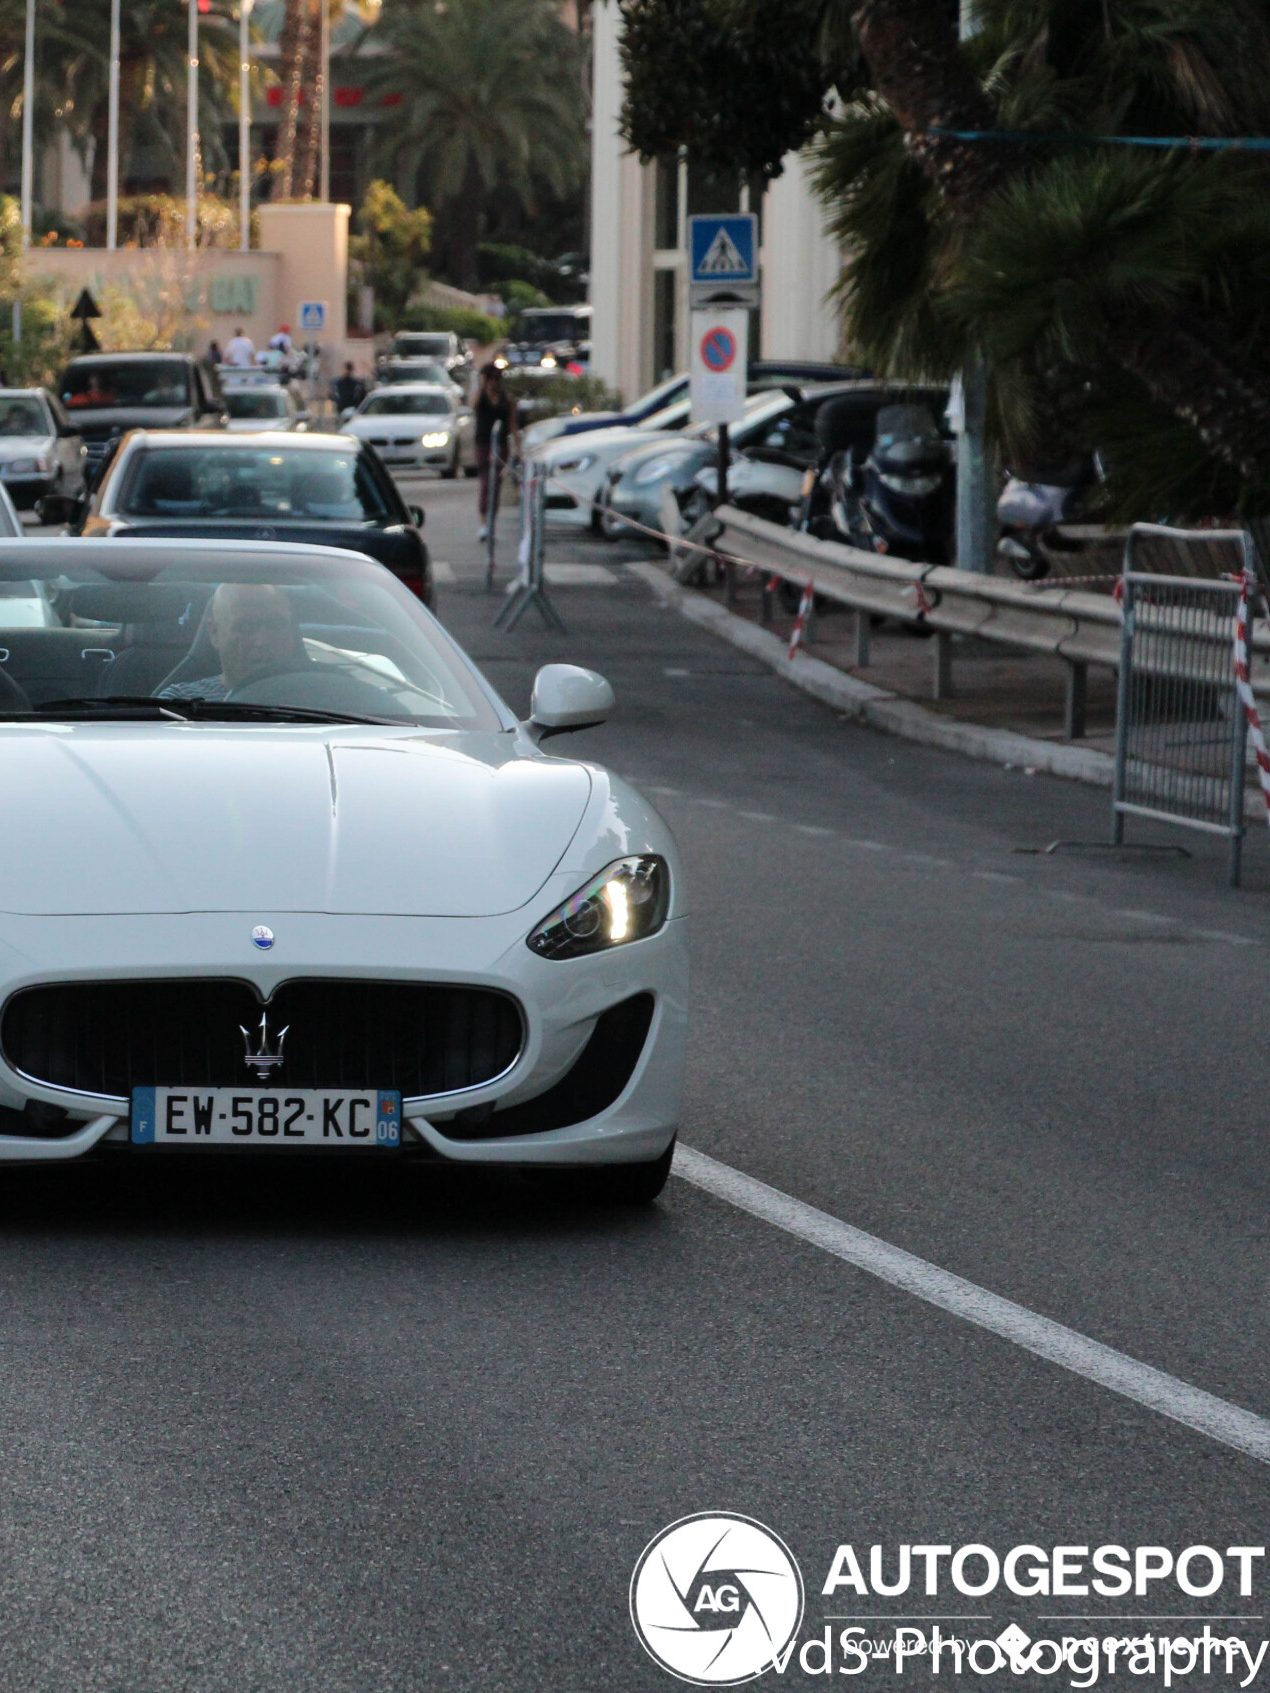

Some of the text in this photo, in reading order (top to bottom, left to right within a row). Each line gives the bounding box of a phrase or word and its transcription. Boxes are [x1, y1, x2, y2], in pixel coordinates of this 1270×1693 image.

[139, 1120, 148, 1133] F
[165, 1095, 371, 1139] EW-582-KC
[377, 1121, 398, 1140] 06
